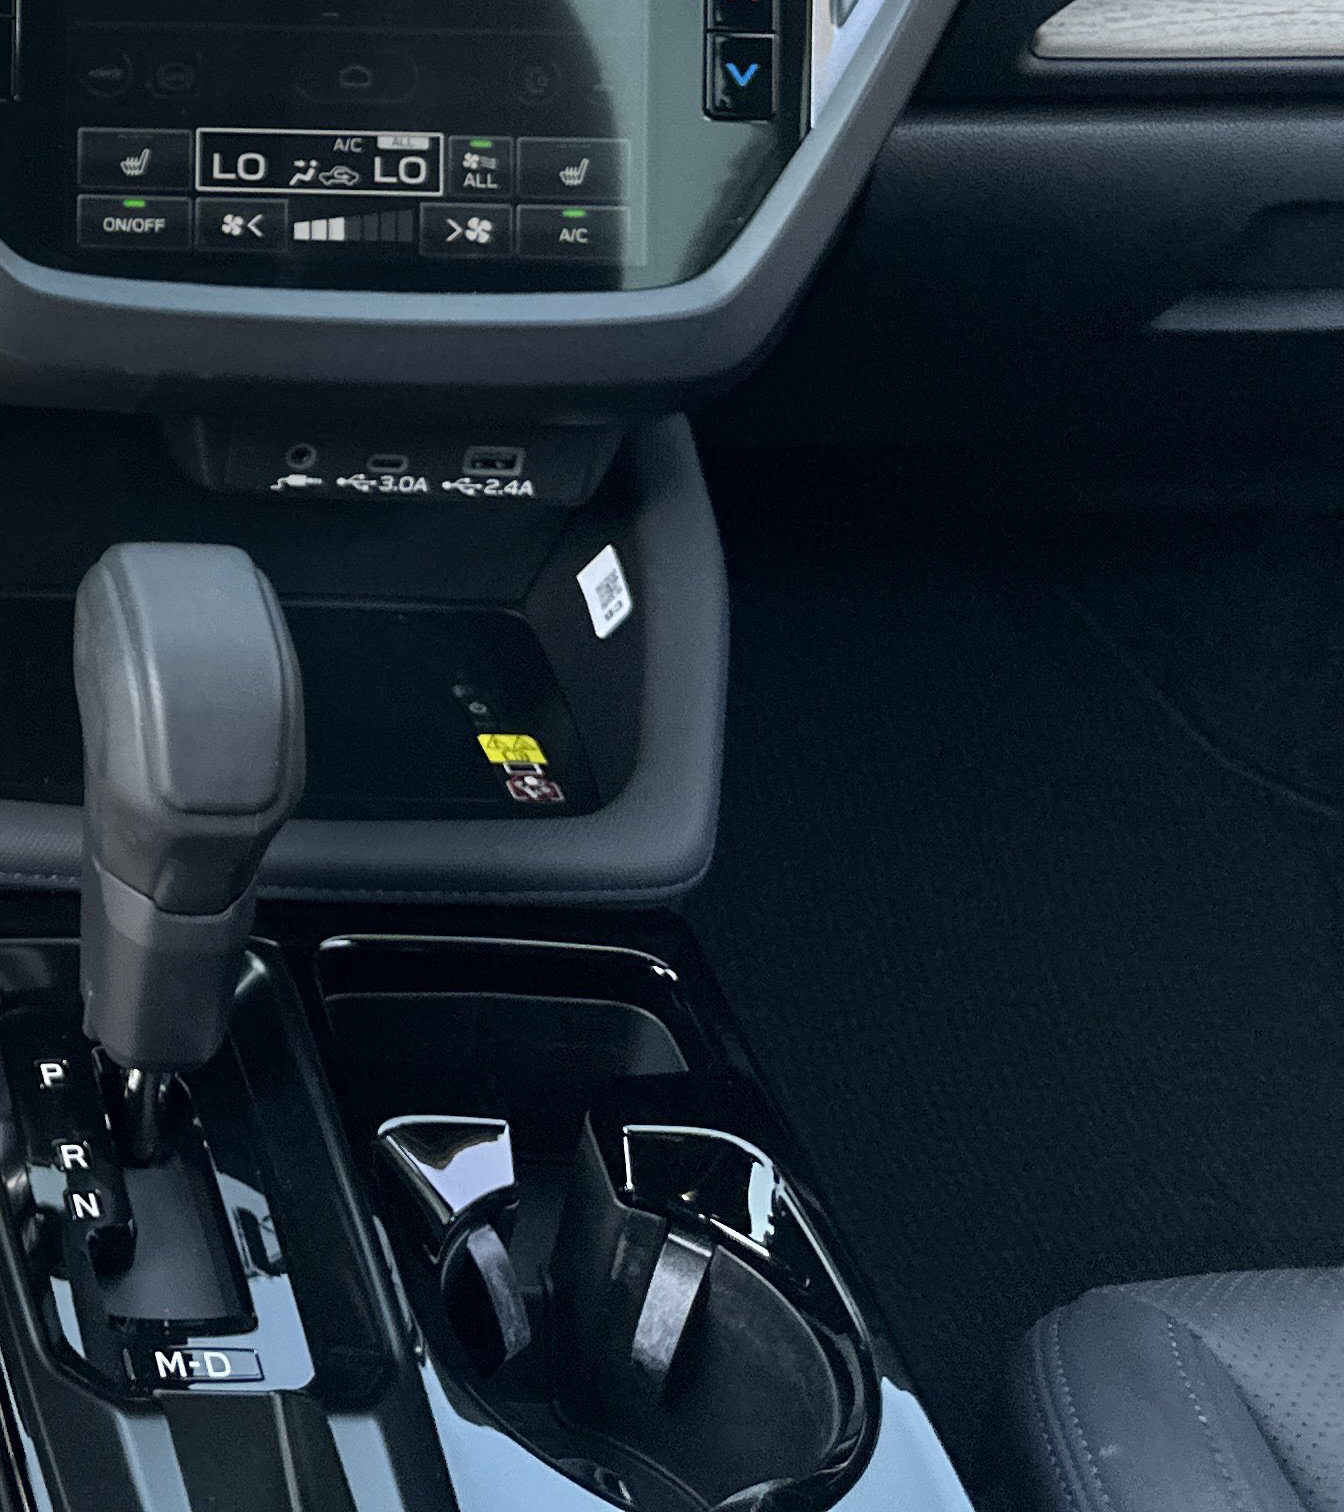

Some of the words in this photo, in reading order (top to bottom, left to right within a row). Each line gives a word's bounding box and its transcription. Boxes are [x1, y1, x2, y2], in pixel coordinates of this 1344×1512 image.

[333, 138, 362, 152] A/C
[391, 137, 413, 148] ALL
[213, 152, 265, 181] LO
[374, 156, 427, 184] LO
[463, 173, 498, 189] ALL
[103, 217, 165, 233] ON/OFF
[559, 228, 589, 243] A/C
[379, 475, 428, 492] 3.0A
[483, 478, 534, 497] 2.4A
[40, 1063, 63, 1087] P
[60, 1144, 88, 1169] R
[72, 1193, 99, 1218] N
